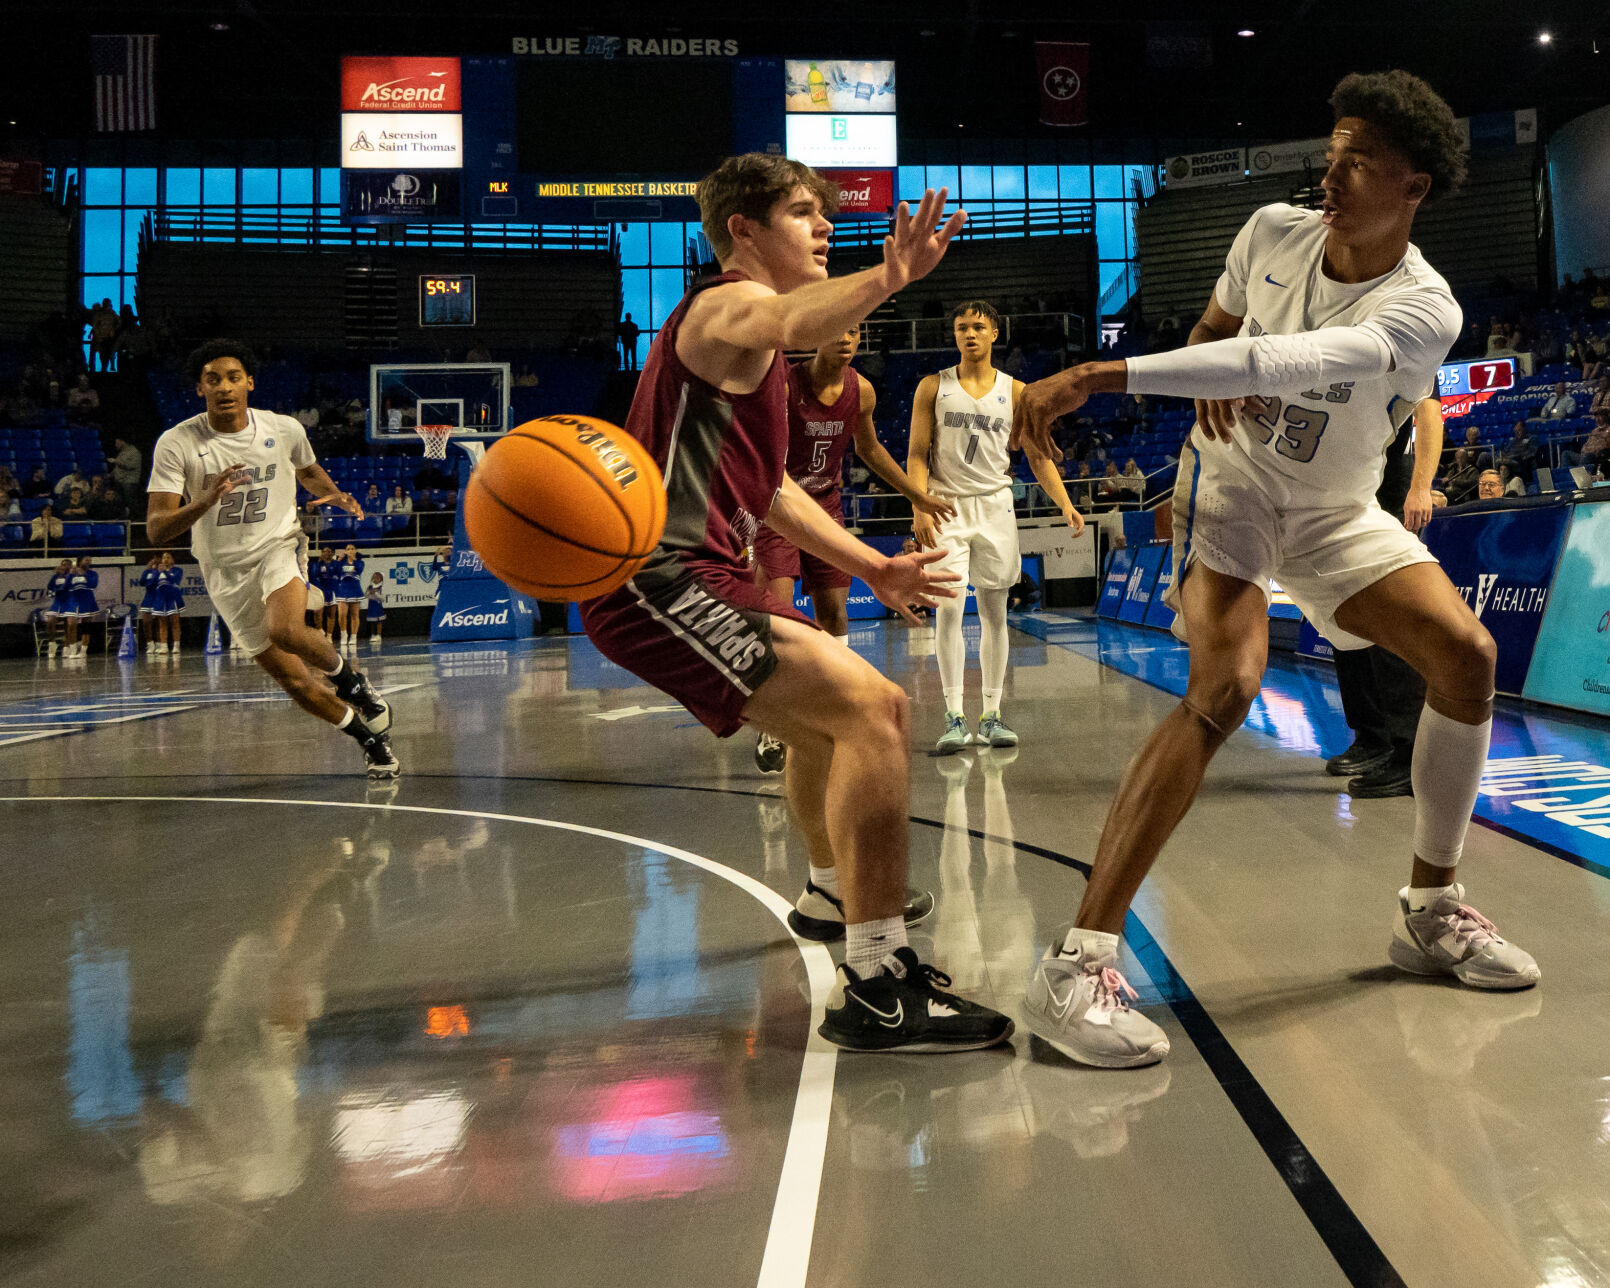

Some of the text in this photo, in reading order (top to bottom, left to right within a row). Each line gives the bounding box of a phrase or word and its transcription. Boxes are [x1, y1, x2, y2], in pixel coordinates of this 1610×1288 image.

[512, 37, 581, 55] BLUE
[627, 38, 739, 56] RAIDERS
[361, 83, 445, 101] Ascend
[360, 101, 443, 109] Federal Credit Union
[379, 130, 437, 140] Ascension
[378, 142, 456, 152] Saint Thomas
[1191, 151, 1239, 166] ROSCOE
[1191, 162, 1240, 177] BROWN
[489, 182, 509, 193] MLK
[539, 183, 697, 196] MIDDLE TENNESSEE BASKETB
[839, 187, 871, 201] end
[426, 280, 461, 296] 59.4
[1437, 368, 1460, 386] 9.5
[1484, 366, 1497, 386] 7
[1441, 402, 1467, 415] ONLY
[943, 411, 1004, 433] ROYALS
[807, 440, 833, 473] 5
[964, 434, 980, 465] 1
[217, 487, 269, 527] 22
[4, 589, 47, 601] ACTI
[393, 593, 434, 603] Tennes
[845, 595, 875, 605] essee
[1491, 587, 1547, 612] HEALTH
[438, 608, 509, 628] Ascend
[667, 583, 766, 672] SPARTA
